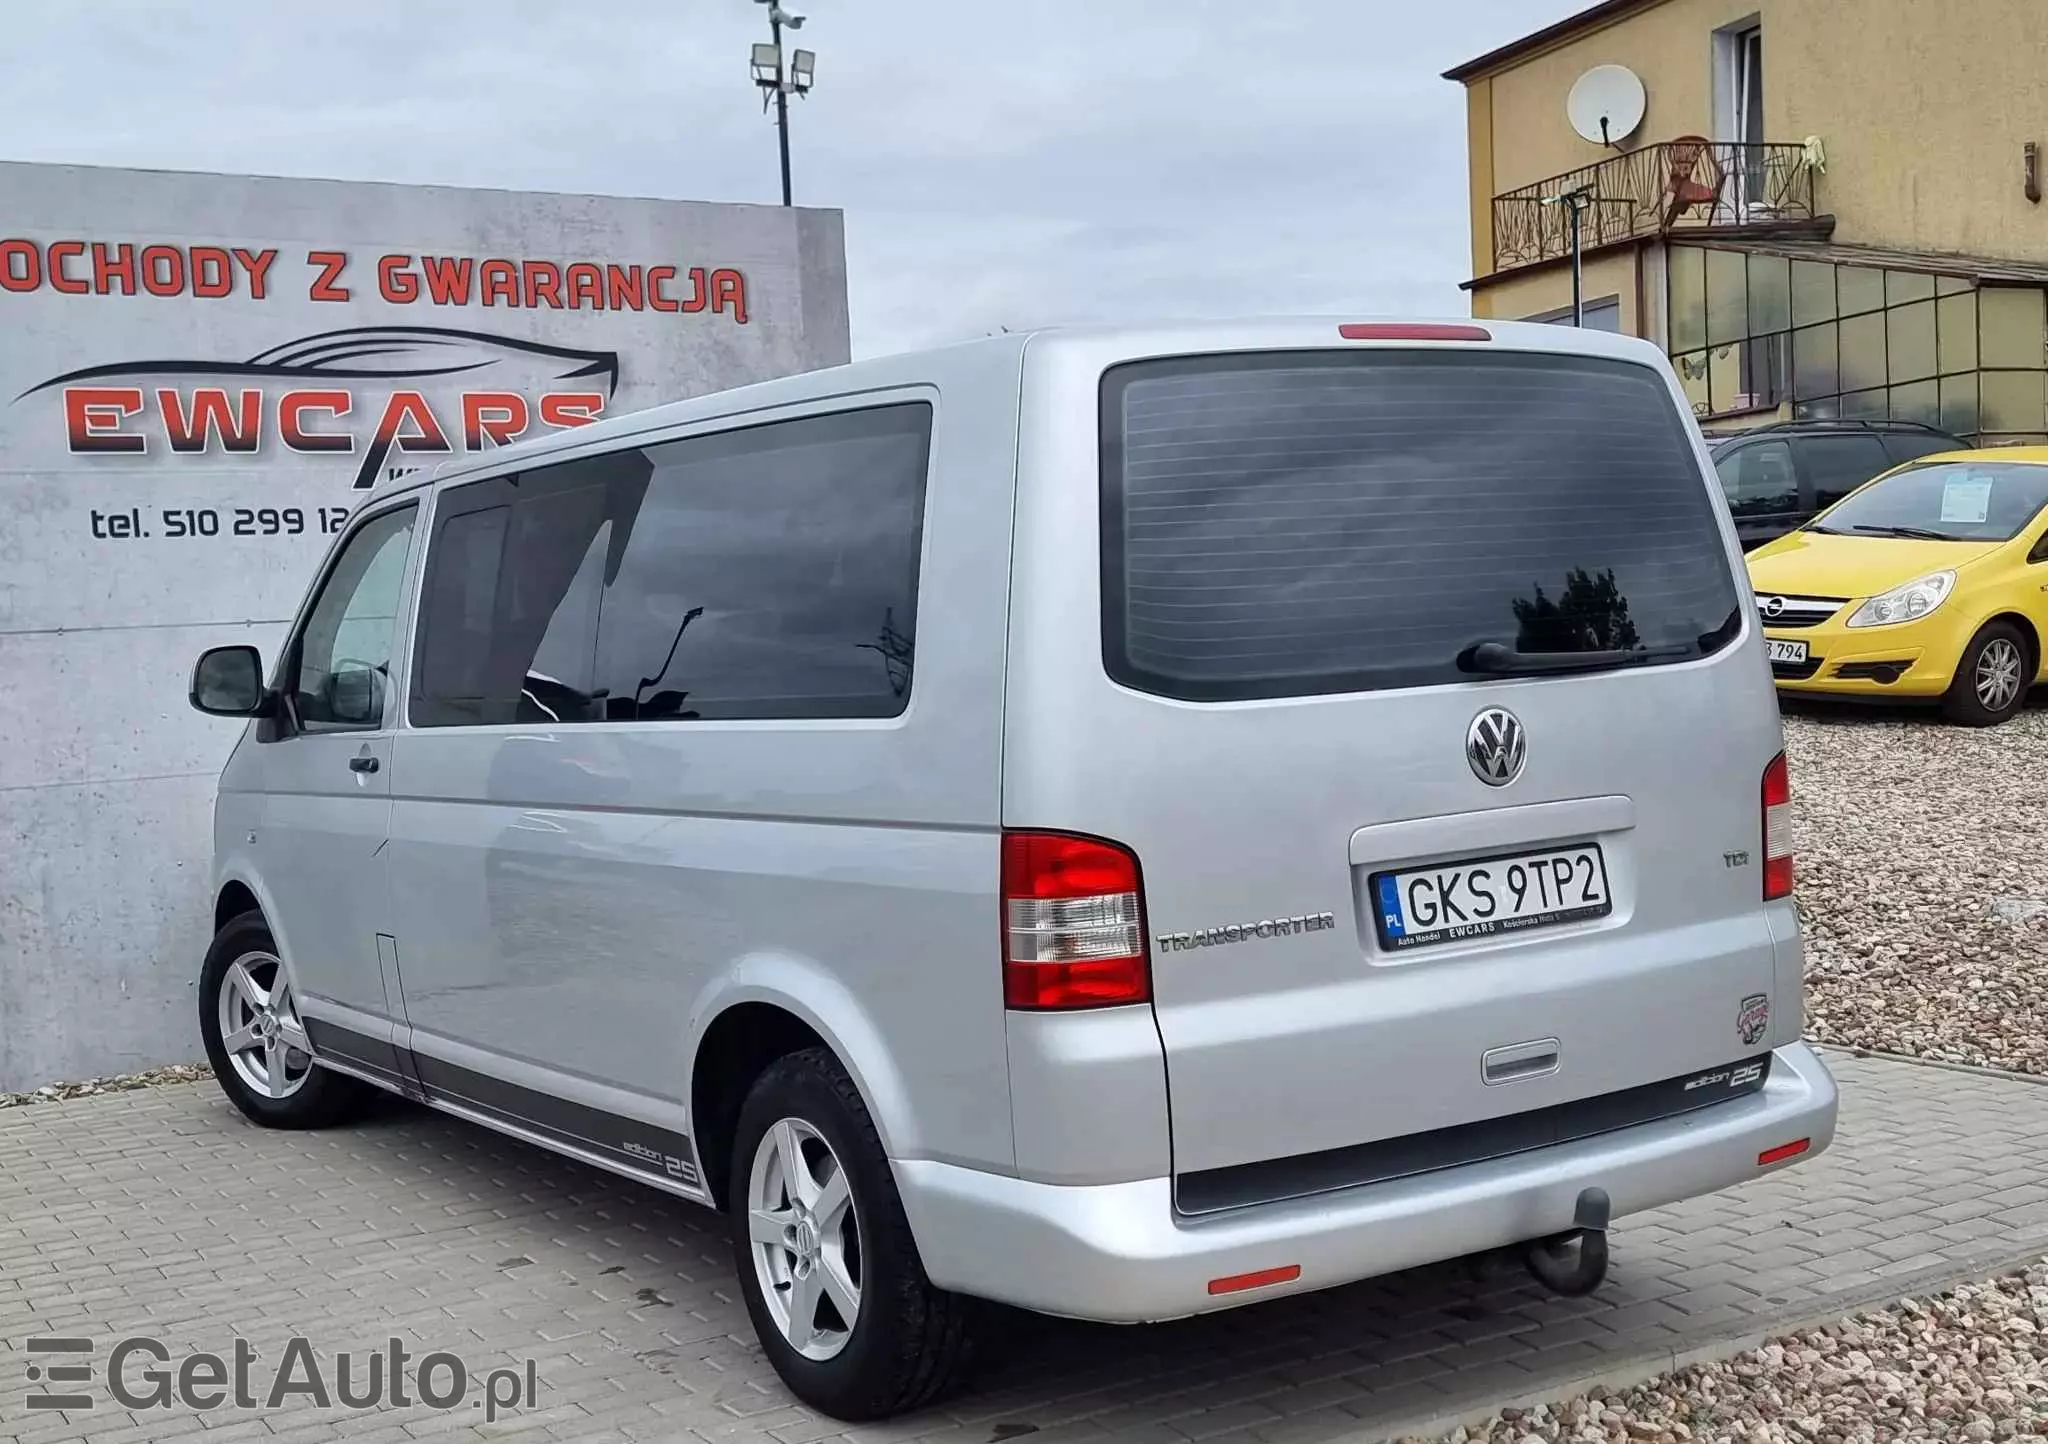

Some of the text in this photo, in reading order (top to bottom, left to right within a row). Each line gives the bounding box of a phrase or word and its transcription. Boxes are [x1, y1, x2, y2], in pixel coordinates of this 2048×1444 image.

[0, 239, 748, 325] OCHODY Z GWARANCJĄ
[63, 387, 606, 491] EWCARS
[91, 508, 151, 539] tel.
[163, 509, 219, 538] 510
[233, 507, 304, 536] 299
[1408, 854, 1601, 927] GKS 9TP2
[1156, 911, 1335, 952] TRANSPORTER
[1386, 914, 1402, 928] PL
[1449, 922, 1495, 938] EWCARS
[1730, 1062, 1763, 1087] 25
[664, 1155, 698, 1183] 25
